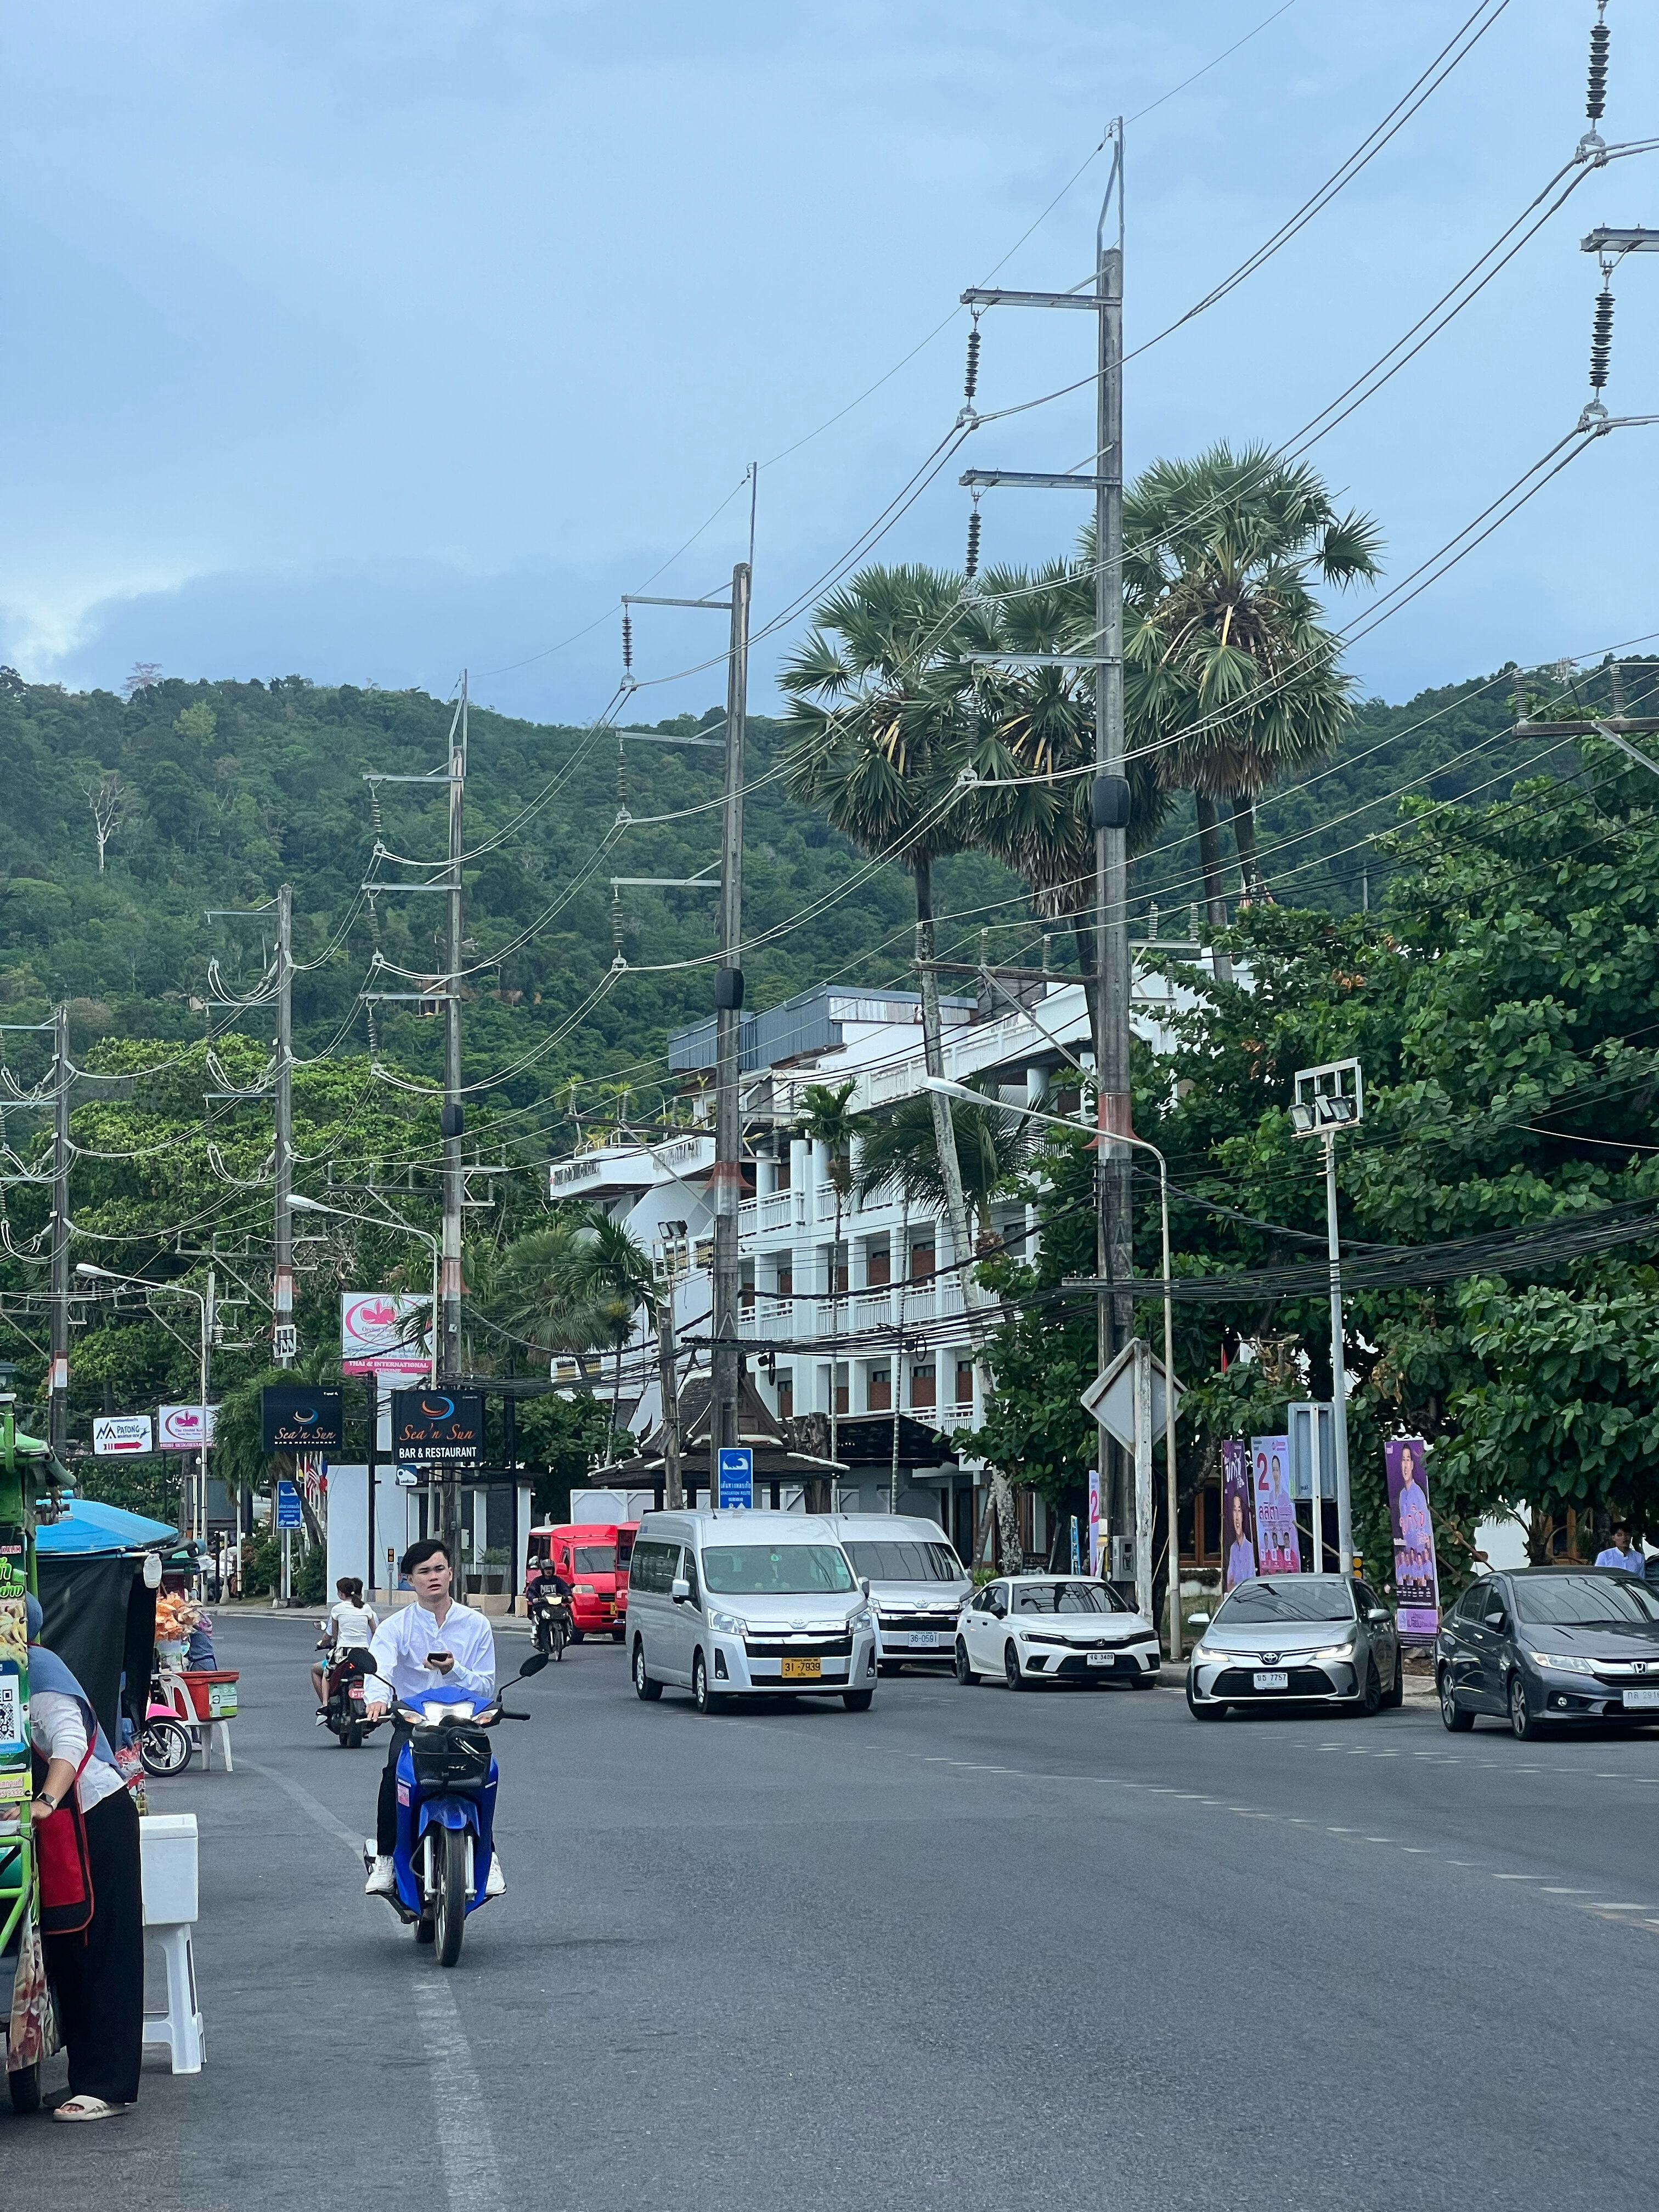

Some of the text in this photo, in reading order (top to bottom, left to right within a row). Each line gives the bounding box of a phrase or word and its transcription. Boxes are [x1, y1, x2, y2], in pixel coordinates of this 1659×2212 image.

[117, 1425, 139, 1434] PATONG
[312, 1427, 336, 1440] Sun
[447, 1424, 476, 1441] Sun
[399, 1447, 477, 1458] BAR & RESTAURANT
[1257, 1453, 1269, 1491] 2
[1090, 1490, 1099, 1524] 2
[540, 1584, 557, 1593] NEW
[785, 1662, 821, 1672] 31-7939
